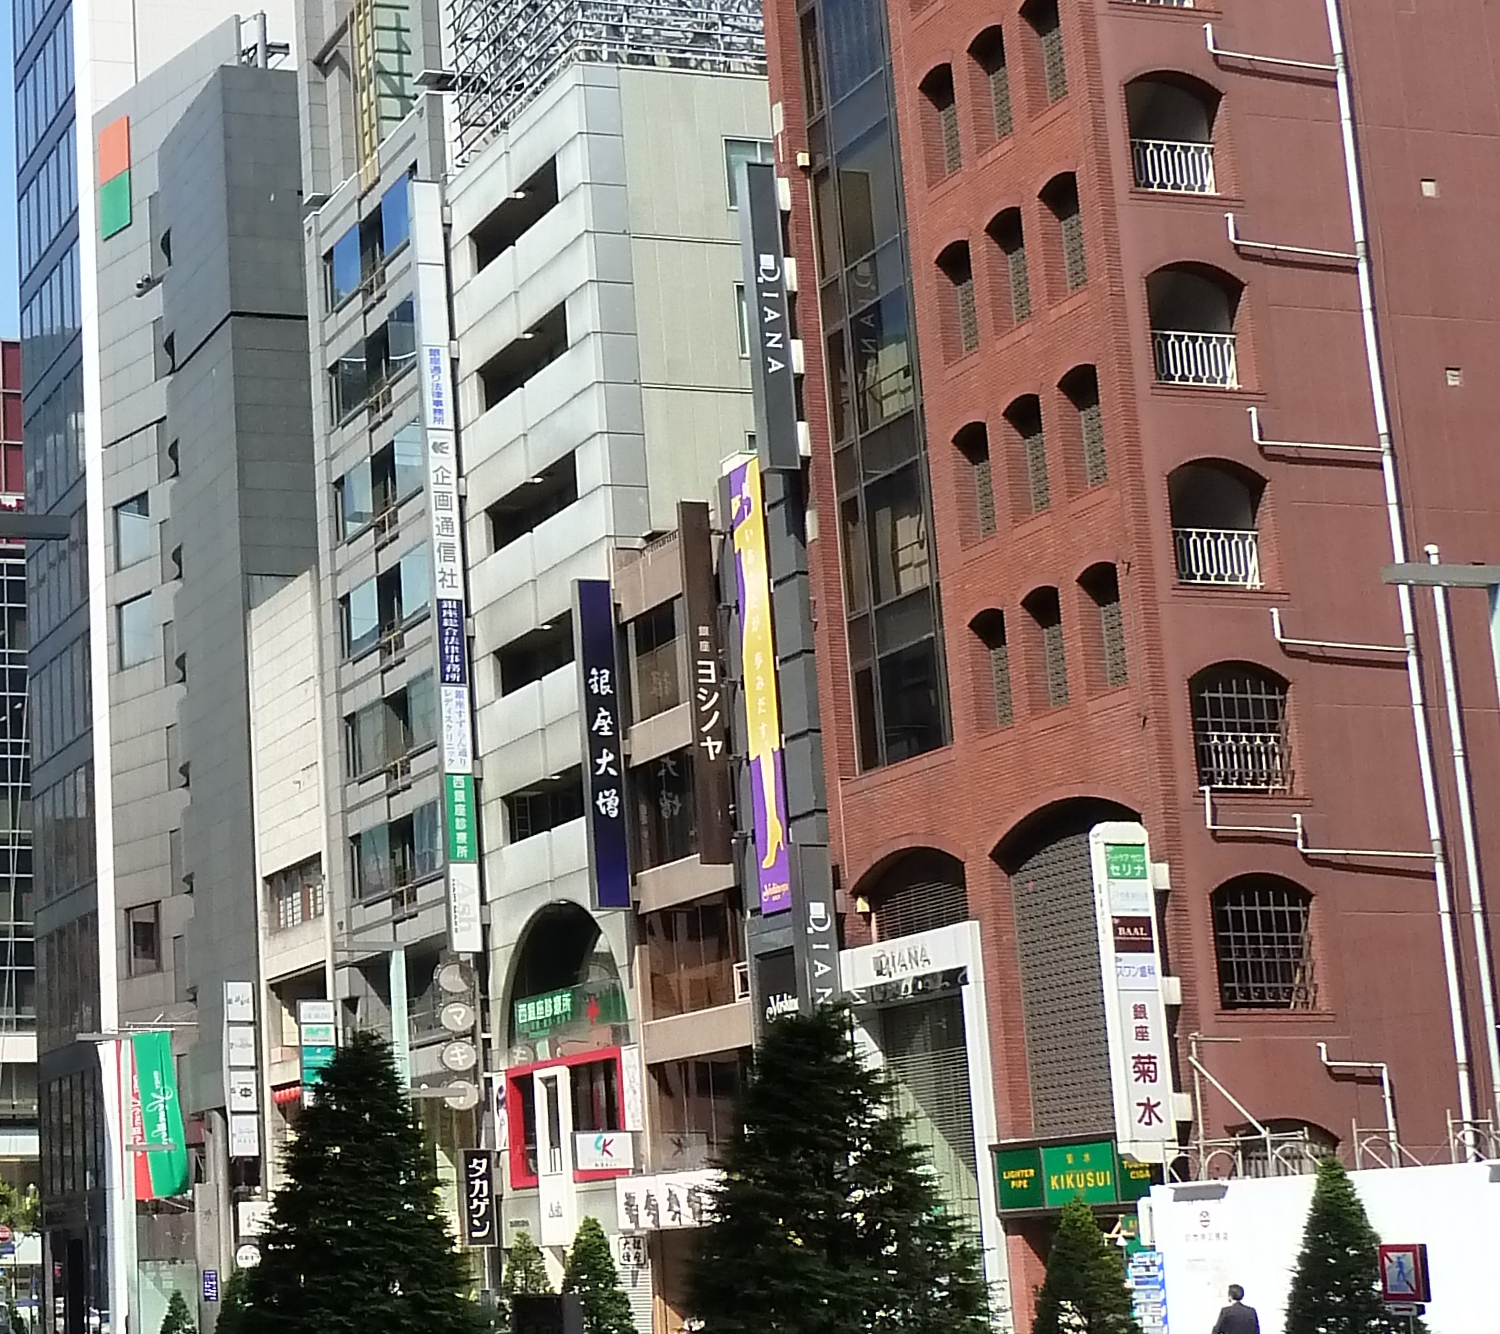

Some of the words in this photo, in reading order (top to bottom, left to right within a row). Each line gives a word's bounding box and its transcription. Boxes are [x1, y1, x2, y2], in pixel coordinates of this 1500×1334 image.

[758, 254, 785, 374] DIANA
[429, 348, 445, 425] 銀座通り法律事務所
[432, 465, 459, 589] 企画通信社
[441, 600, 461, 682] 銀座総合法律事務所
[698, 626, 710, 652] 銀座
[697, 660, 723, 761] ヨシノヤ
[588, 667, 620, 818] 銀座大増
[453, 775, 468, 858] 西銀座診療所
[1110, 864, 1145, 876] セリナ
[1117, 926, 1147, 937] BAAL
[871, 946, 932, 979] DIANA
[518, 993, 572, 1024] 西銀座診療所
[1132, 1003, 1150, 1042] 銀座
[1131, 1054, 1164, 1126] 菊水
[468, 1158, 490, 1238] タカゲン
[1003, 1168, 1035, 1179] LIGHTER
[1011, 1179, 1028, 1189] PIPE
[1051, 1171, 1111, 1190] KIKUSUI
